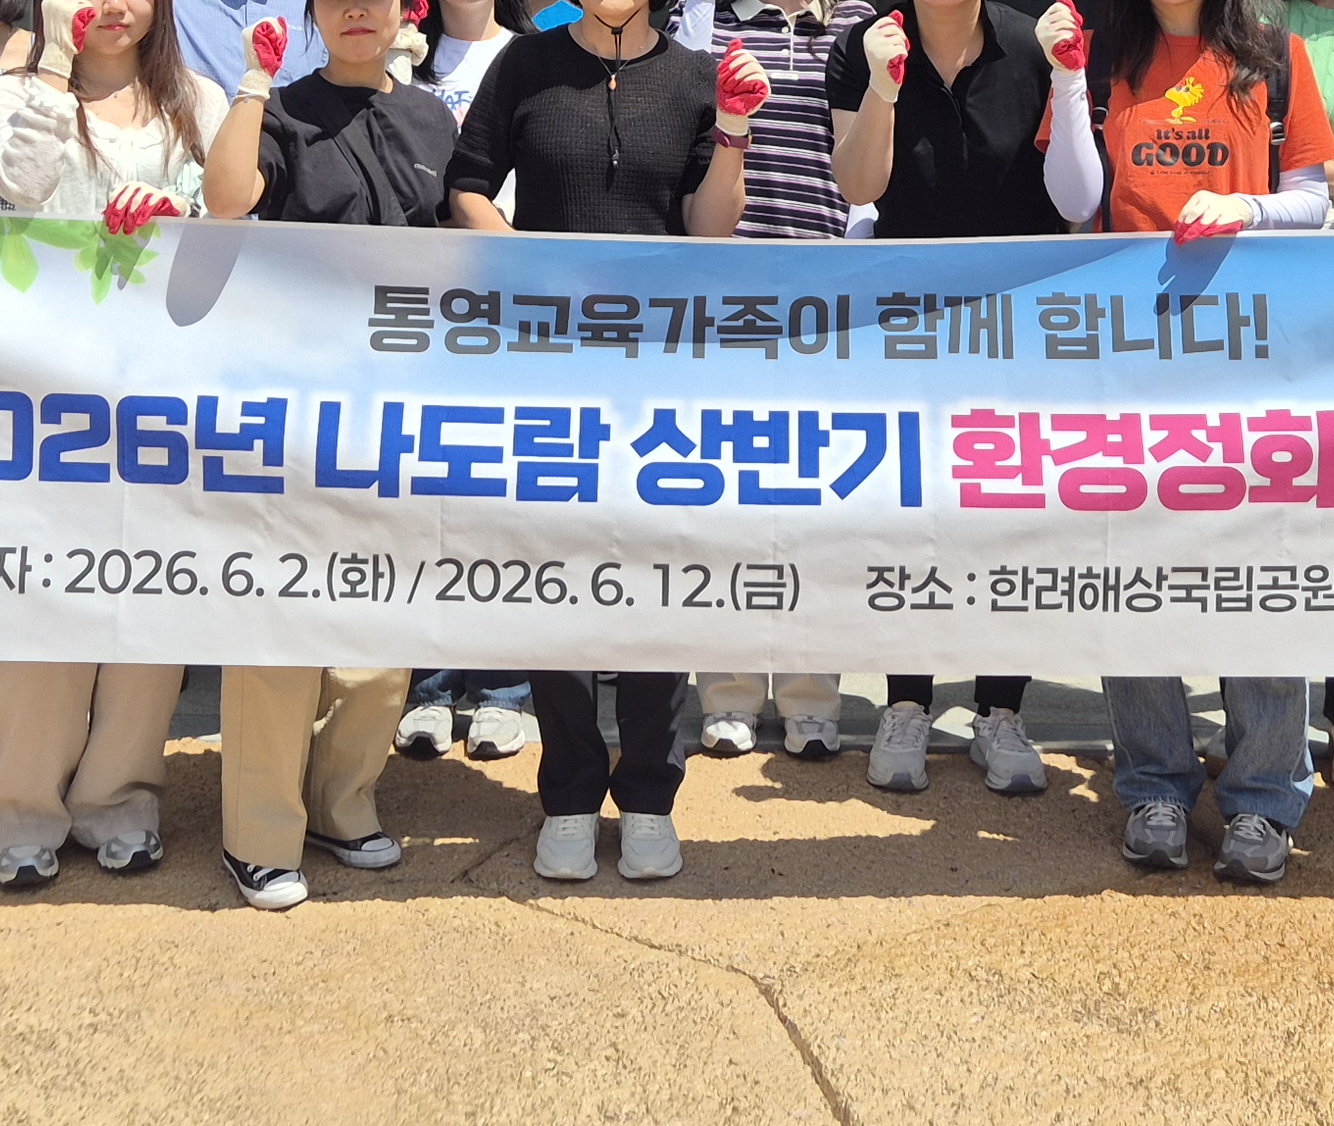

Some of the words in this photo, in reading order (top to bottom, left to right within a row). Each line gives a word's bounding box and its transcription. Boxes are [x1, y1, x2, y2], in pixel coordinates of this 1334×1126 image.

[1131, 142, 1230, 167] GOOD
[1186, 128, 1211, 140] all
[874, 291, 1014, 360] 함께
[1035, 292, 1270, 361] 합니다!
[314, 400, 612, 503] 나도람
[630, 408, 924, 508] 상반기
[66, 547, 208, 596] 2026.
[221, 551, 265, 597] 6.
[278, 550, 396, 602] 2.(화)
[434, 558, 579, 606] 2026.
[590, 561, 635, 606] 6.
[652, 560, 801, 611] 12.(금)
